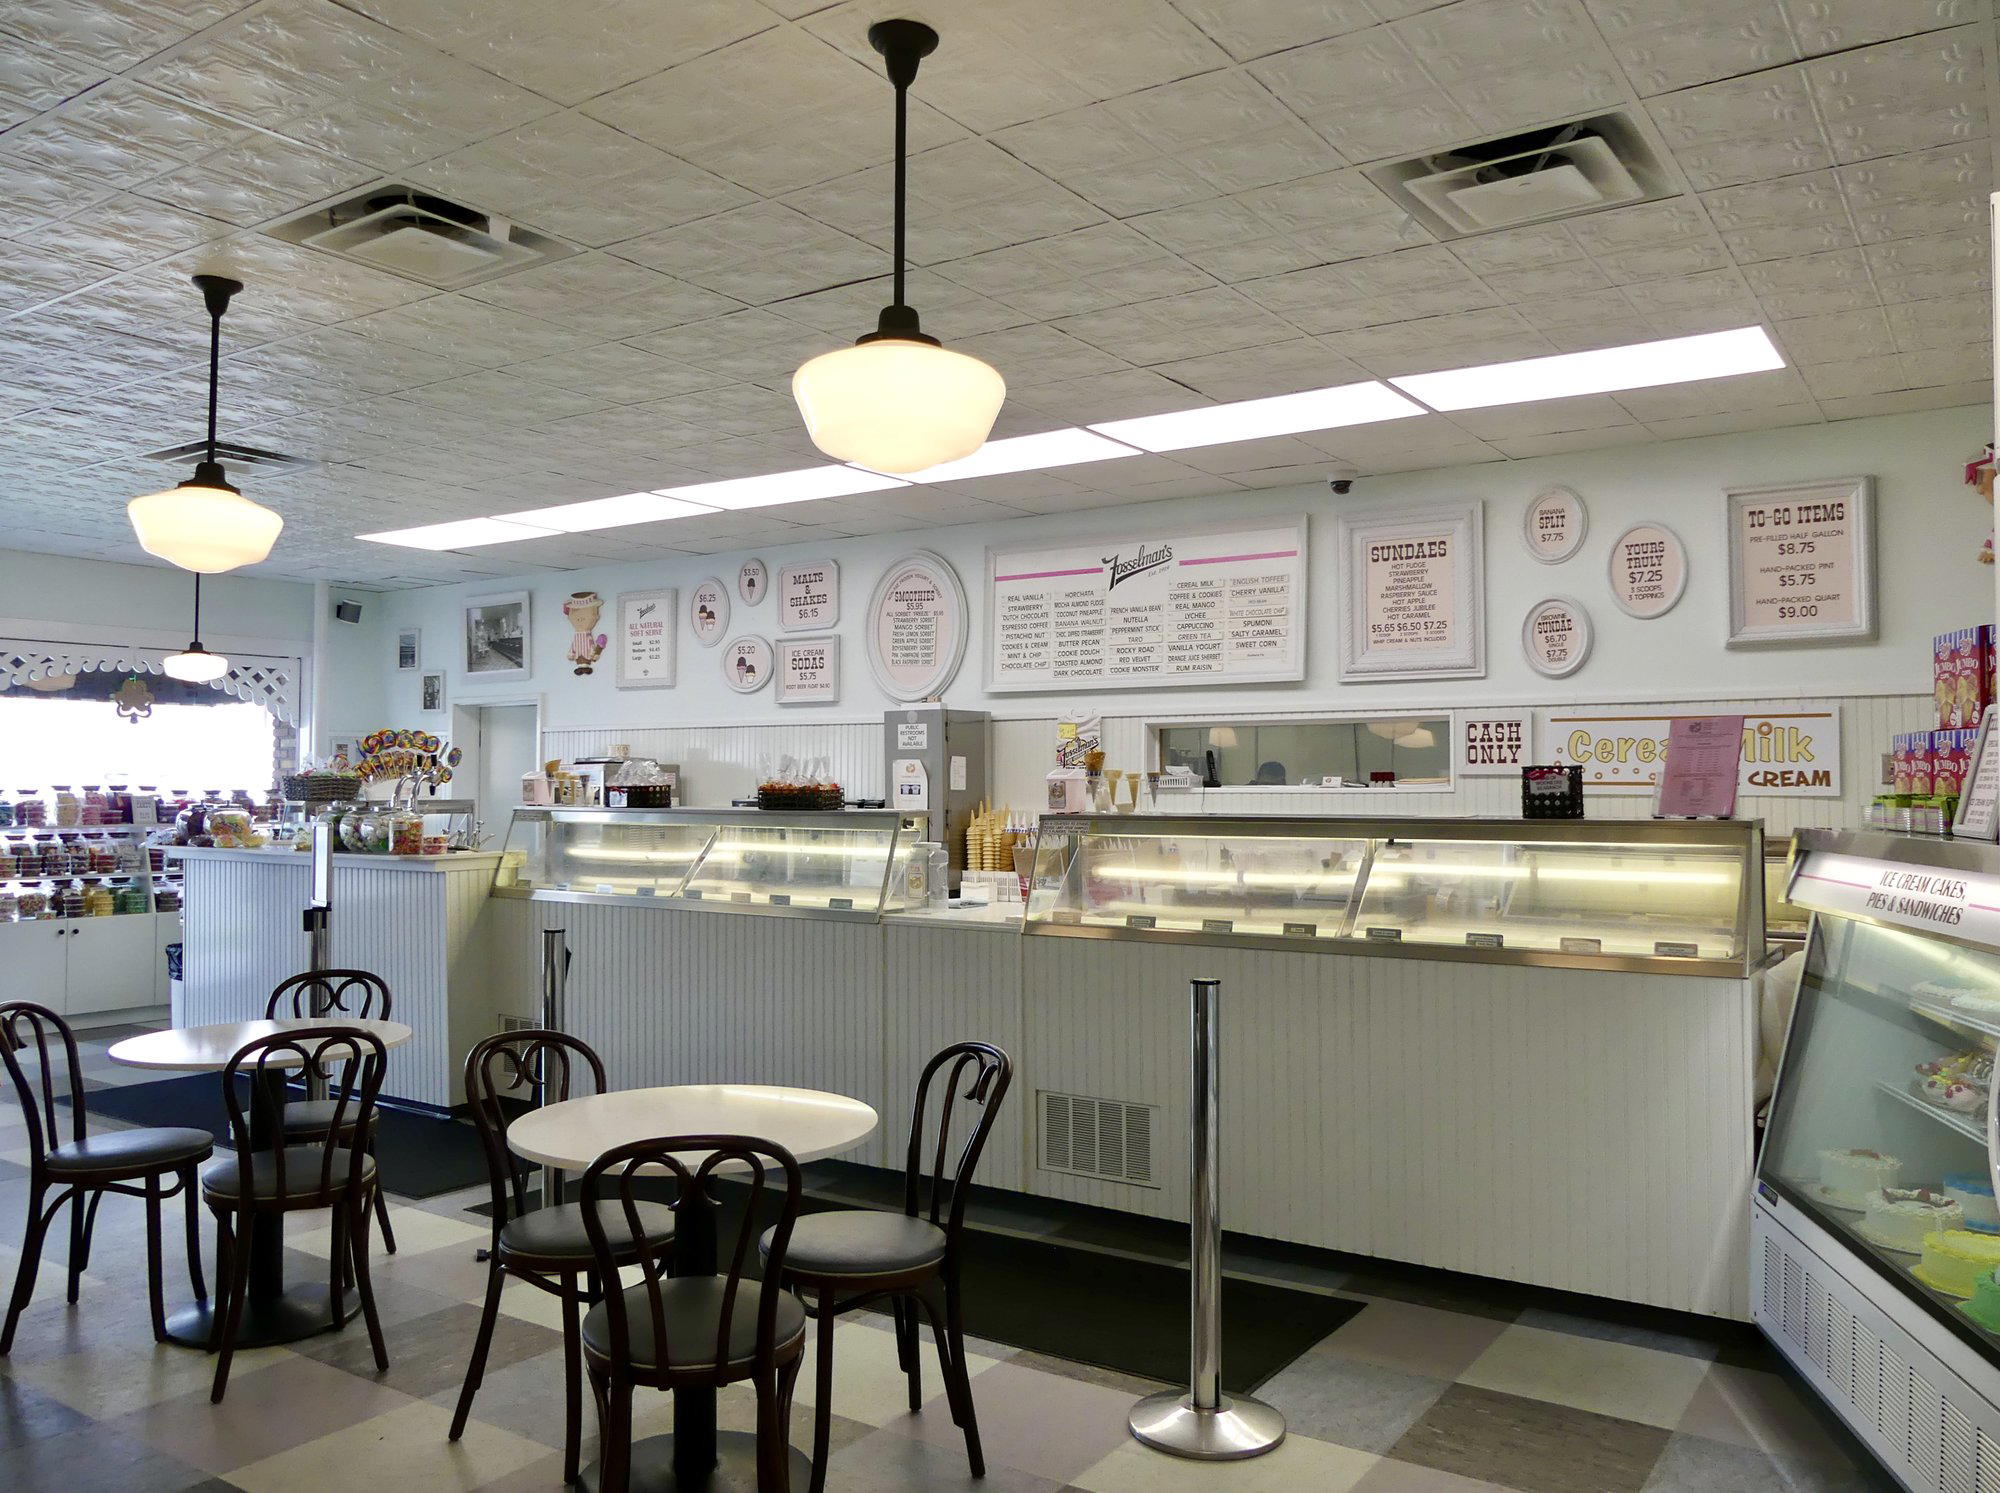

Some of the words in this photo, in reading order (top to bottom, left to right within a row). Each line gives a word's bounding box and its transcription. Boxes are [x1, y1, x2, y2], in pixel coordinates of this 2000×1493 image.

[1749, 508, 1791, 528] TO-GO
[1797, 503, 1844, 523] ITEMS
[1539, 515, 1565, 529] SPLIT
[1541, 533, 1564, 542] $7.75
[1812, 529, 1844, 538] GALLON
[1372, 541, 1446, 562] SUNDAES
[1625, 541, 1665, 556] YOURS
[1778, 542, 1815, 555] $8.75
[1101, 544, 1173, 591] Fosselman's
[1626, 555, 1664, 569] TRULY
[1389, 569, 1428, 577] STRAWBERRY
[1760, 564, 1816, 573] HAND-PACKED
[793, 572, 823, 585] MALTS
[1629, 570, 1663, 584] $7.25
[1779, 574, 1815, 586] $5.75
[805, 585, 811, 594] &
[1259, 586, 1284, 594] VANILLA
[1385, 583, 1432, 591] MARSHMALLOW
[1636, 585, 1662, 593] SCOOPS
[700, 594, 716, 603] $6.25
[790, 594, 827, 607] SHAKES
[895, 591, 934, 602] SMOOTHIES
[1634, 592, 1664, 600] TOPPINGS
[1756, 596, 1811, 604] HAND-PACKED
[907, 602, 923, 610] $5.95
[1008, 604, 1043, 612] STRAWBERRY
[1778, 605, 1818, 618] $9.00
[799, 608, 819, 619] $6.15
[640, 621, 663, 629] NATURAL
[1177, 622, 1214, 630] CAPPUCCINO
[1372, 624, 1395, 633] $5.65
[1397, 622, 1421, 631] $6.50
[1424, 621, 1447, 630] $7.25
[1537, 619, 1572, 634] SUNDAE
[1545, 634, 1567, 643] $6.70
[738, 646, 755, 655] $5.20
[1546, 649, 1568, 657] $7.75
[791, 657, 824, 670] SODAS
[1956, 658, 1978, 674] JUMBO
[800, 672, 816, 680] $5.75
[1467, 722, 1521, 743] CASH
[1568, 729, 1668, 763] Cere
[1468, 744, 1521, 764] ONLY
[1934, 758, 1957, 774] JUMBO
[1748, 770, 1831, 787] CREAM
[1880, 871, 1895, 888] ICE
[1897, 873, 1929, 893] CREAM
[1930, 878, 1967, 902] CAKES,
[1866, 892, 1886, 909] PIES
[1887, 897, 1895, 912] &
[1896, 896, 1963, 926] SANDWICHES
